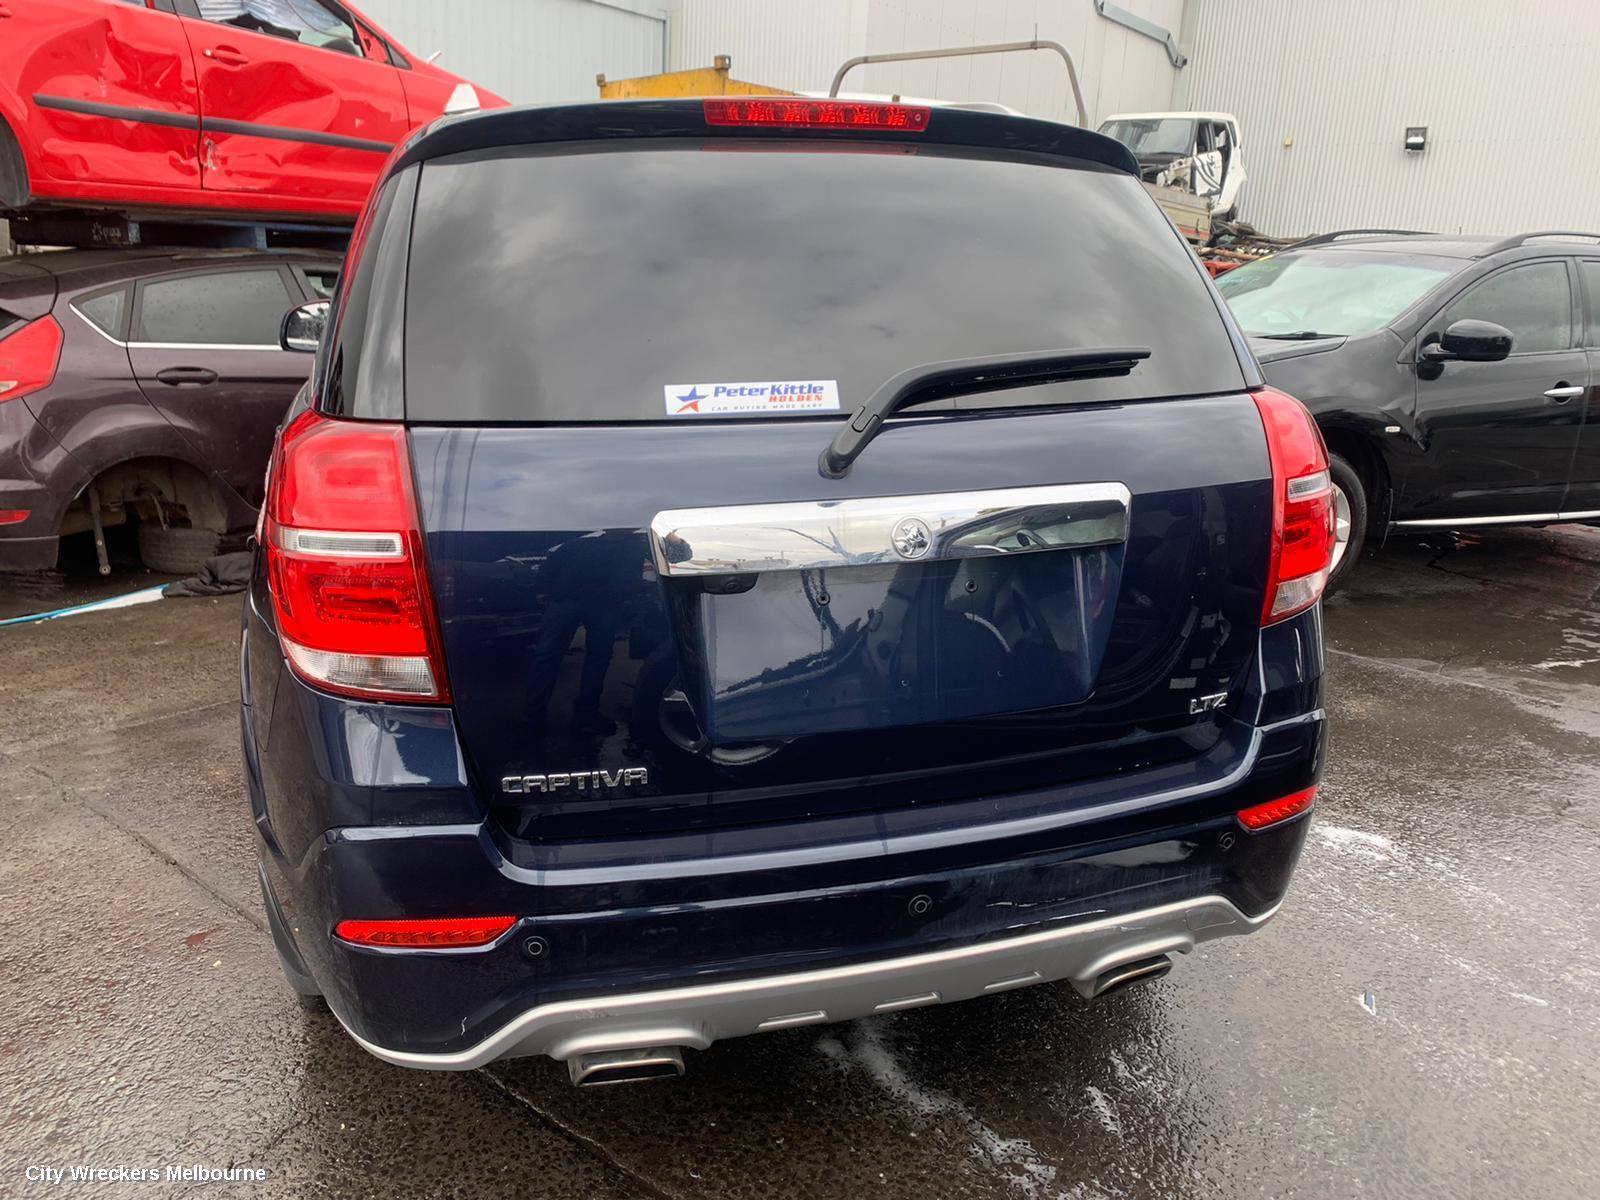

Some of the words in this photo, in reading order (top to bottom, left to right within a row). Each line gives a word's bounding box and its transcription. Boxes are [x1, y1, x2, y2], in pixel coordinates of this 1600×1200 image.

[713, 386, 769, 397] Peter
[770, 384, 823, 395] Kittle
[768, 394, 823, 402] HOLDEN
[1190, 691, 1228, 715] LTZ
[501, 767, 648, 793] CAPTIVA
